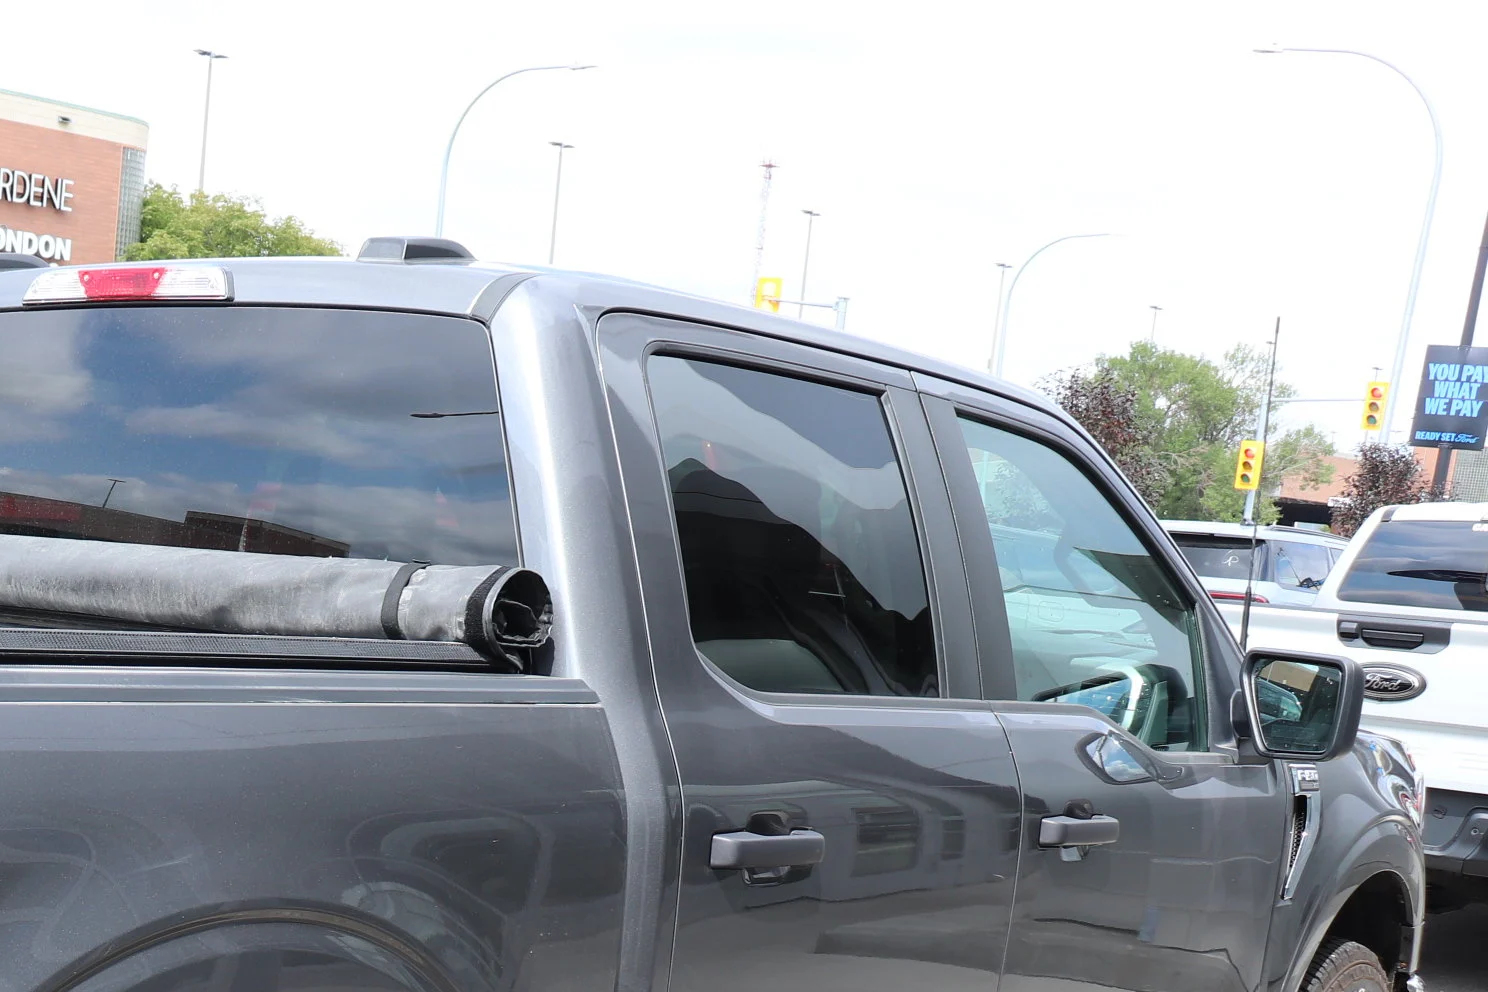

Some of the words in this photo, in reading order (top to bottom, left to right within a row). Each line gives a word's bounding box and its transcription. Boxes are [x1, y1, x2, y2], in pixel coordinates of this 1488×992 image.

[1428, 363, 1460, 381] YOU
[1433, 381, 1480, 399] WHAT
[1424, 398, 1449, 415] WE
[1450, 400, 1483, 418] PAY
[1415, 431, 1441, 441] READY
[1441, 432, 1457, 442] SET
[1455, 433, 1480, 443] Ford
[1363, 673, 1402, 690] Ford
